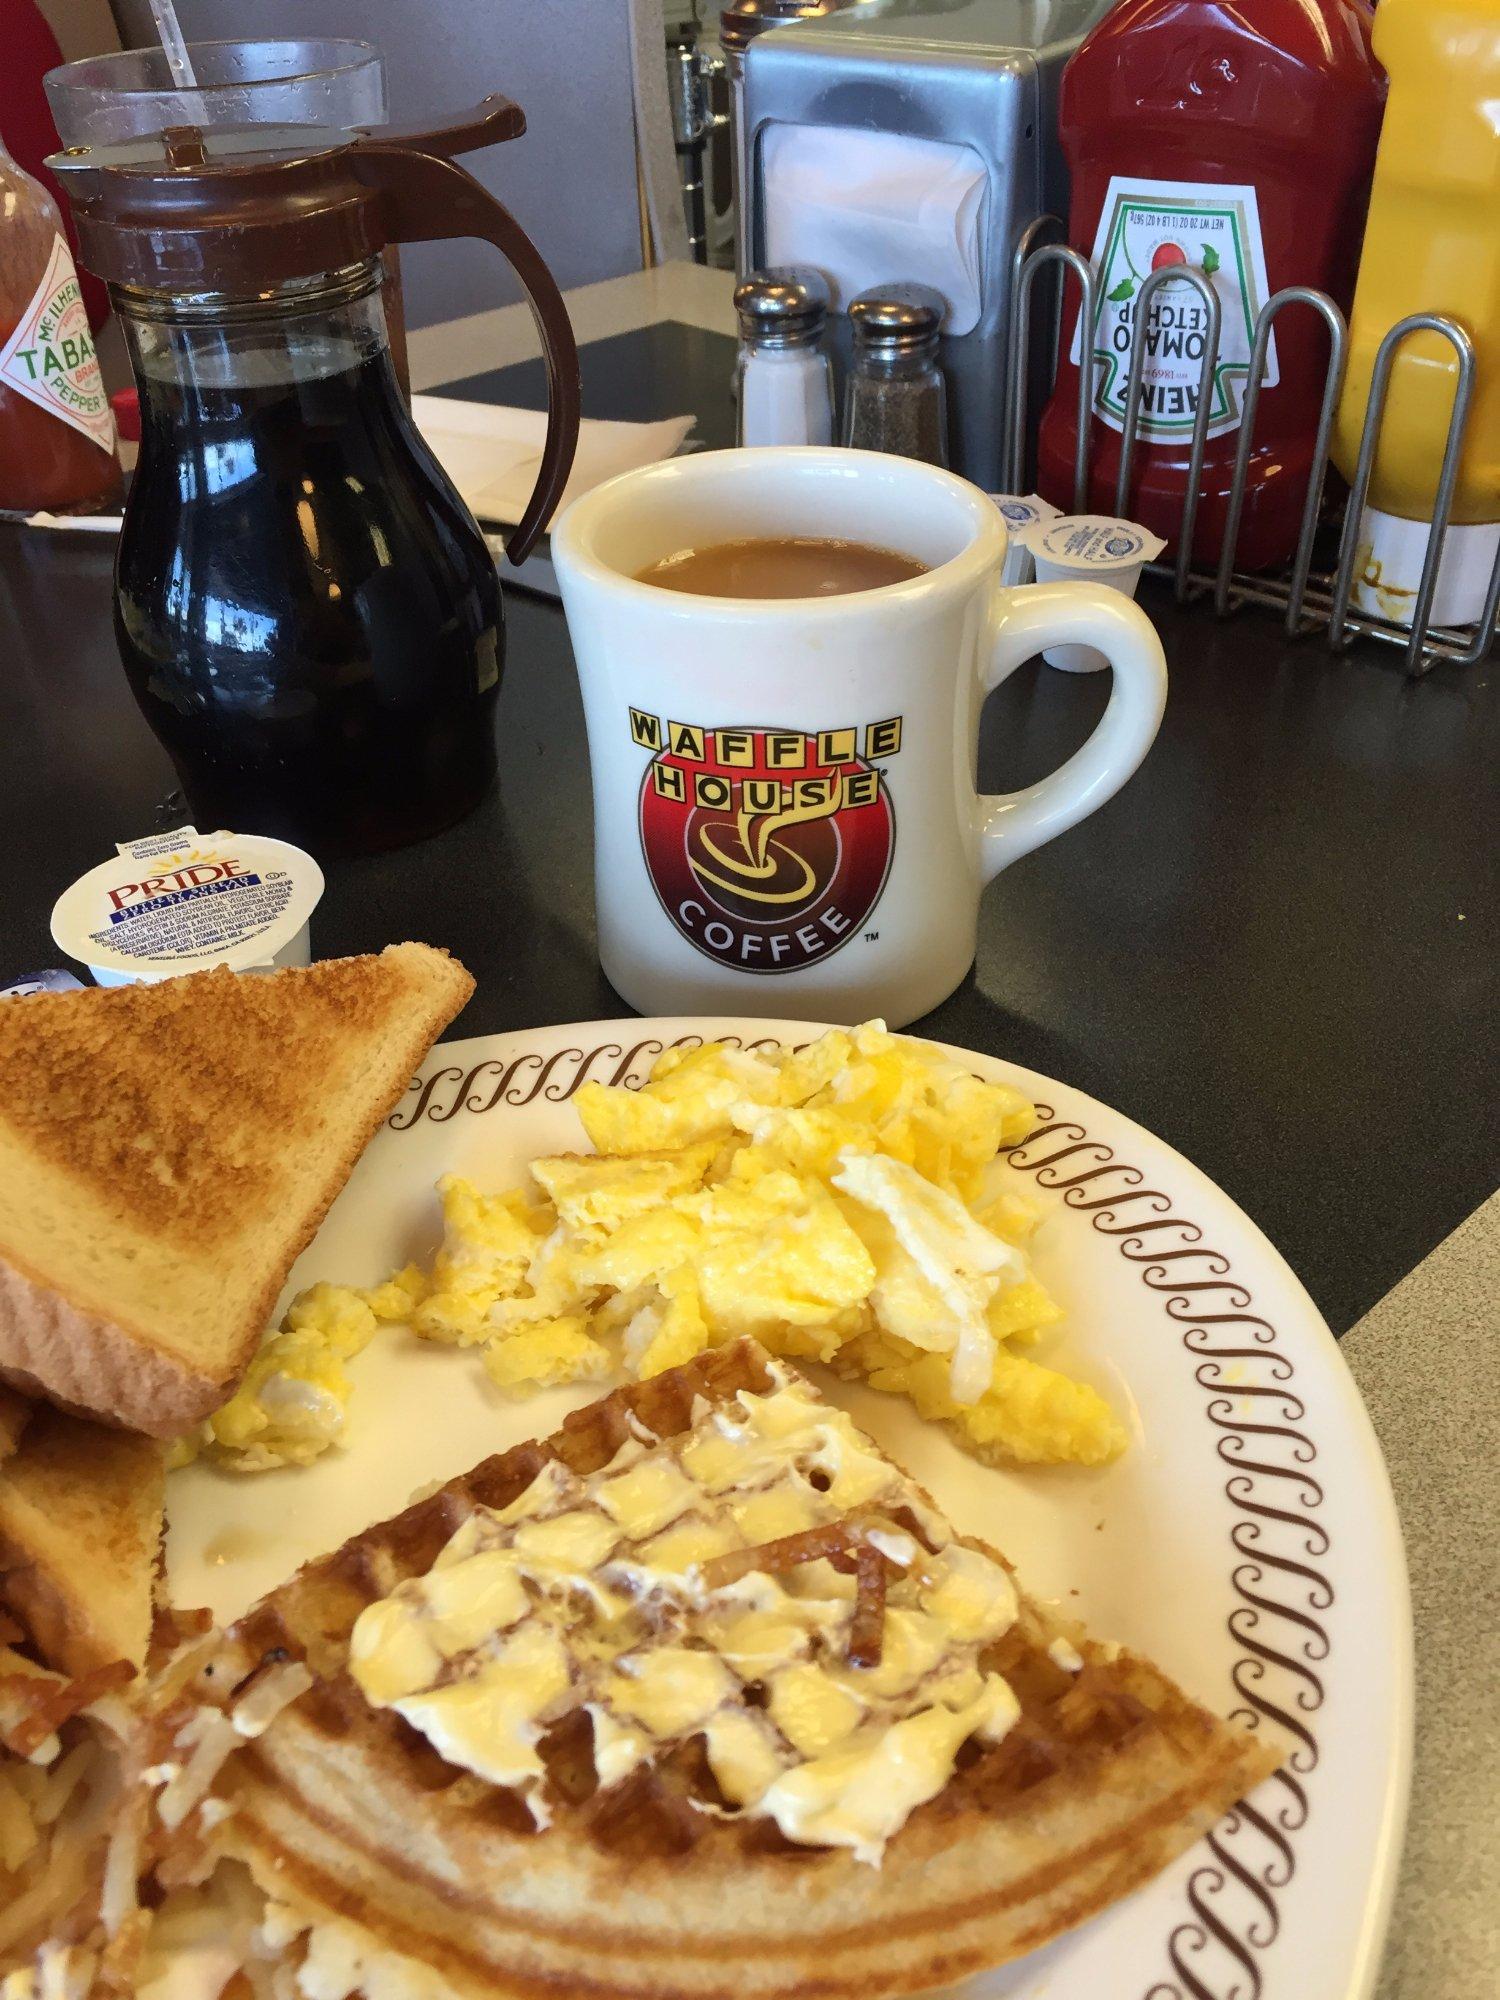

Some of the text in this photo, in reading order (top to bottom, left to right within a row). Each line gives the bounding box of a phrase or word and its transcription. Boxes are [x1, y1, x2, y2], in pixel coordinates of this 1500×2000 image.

[1162, 216, 1170, 227] LB
[1180, 217, 1189, 228] OZ
[1190, 217, 1198, 228] 20
[1200, 218, 1210, 229] WT
[1211, 218, 1224, 230] NET
[1114, 325, 1221, 361] OMAO
[1152, 369, 1173, 379] 1869
[50, 376, 100, 411] PEPPER
[631, 711, 897, 765] WAFFLE
[656, 766, 874, 811] HOUSE
[107, 860, 251, 910] PRIDE
[174, 904, 187, 912] AND
[220, 886, 265, 900] HYDROGENATED
[227, 891, 264, 904] VEGETABLE
[121, 944, 147, 955] CALCIUM
[193, 923, 213, 933] ADDED
[222, 914, 247, 925] PROTECT
[147, 923, 168, 933] PECTIN
[163, 924, 190, 935] NATURAL
[679, 899, 852, 961] COFFEE
[133, 946, 165, 958] CAROTENE
[193, 930, 219, 941] VITAMIN
[226, 920, 257, 932] PALMITATE
[864, 932, 879, 943] TM
